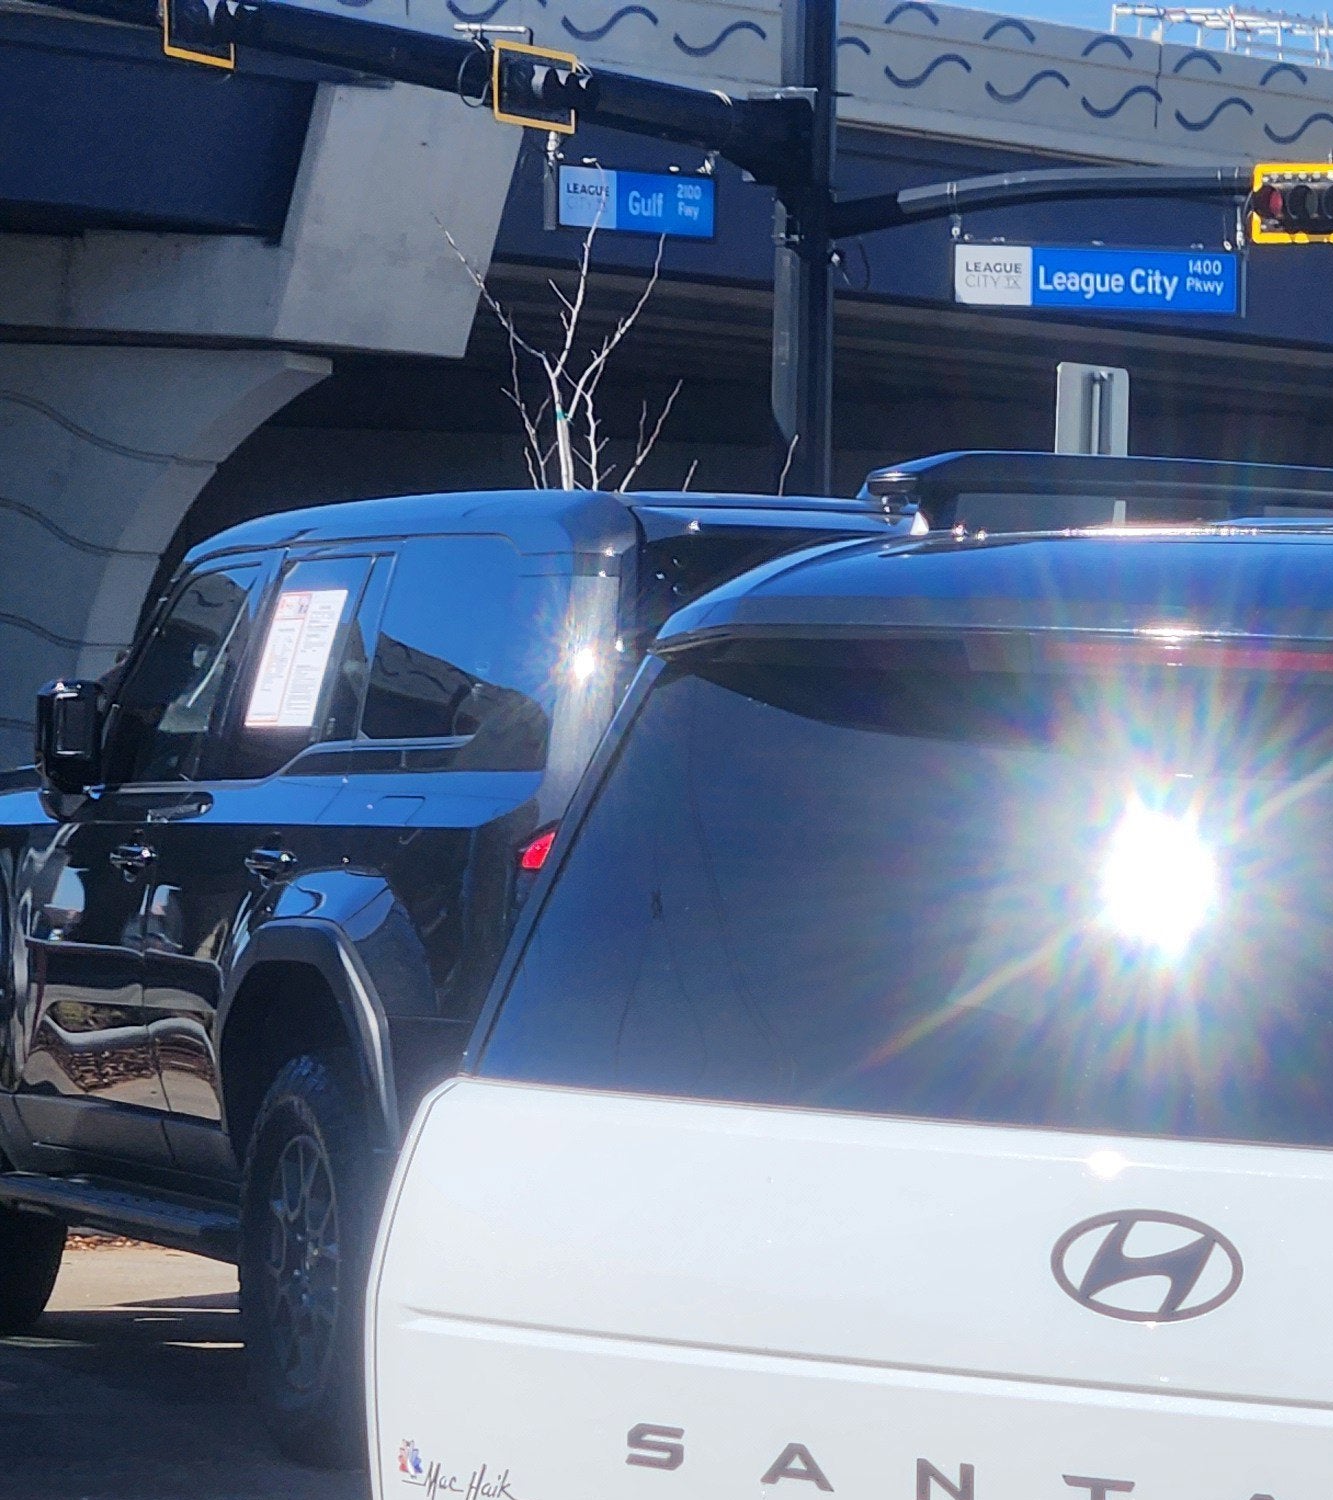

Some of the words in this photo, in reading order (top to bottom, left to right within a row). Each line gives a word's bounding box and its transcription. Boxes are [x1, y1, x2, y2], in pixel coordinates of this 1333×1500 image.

[566, 182, 610, 197] LEAGUE
[628, 190, 664, 217] Gulf
[677, 201, 700, 220] Fwy
[965, 261, 1023, 275] LEAGUE
[1188, 259, 1222, 276] 1400
[965, 274, 998, 289] CITY
[1039, 264, 1125, 299] League
[1130, 268, 1178, 301] City
[1186, 277, 1224, 296] Pkwy
